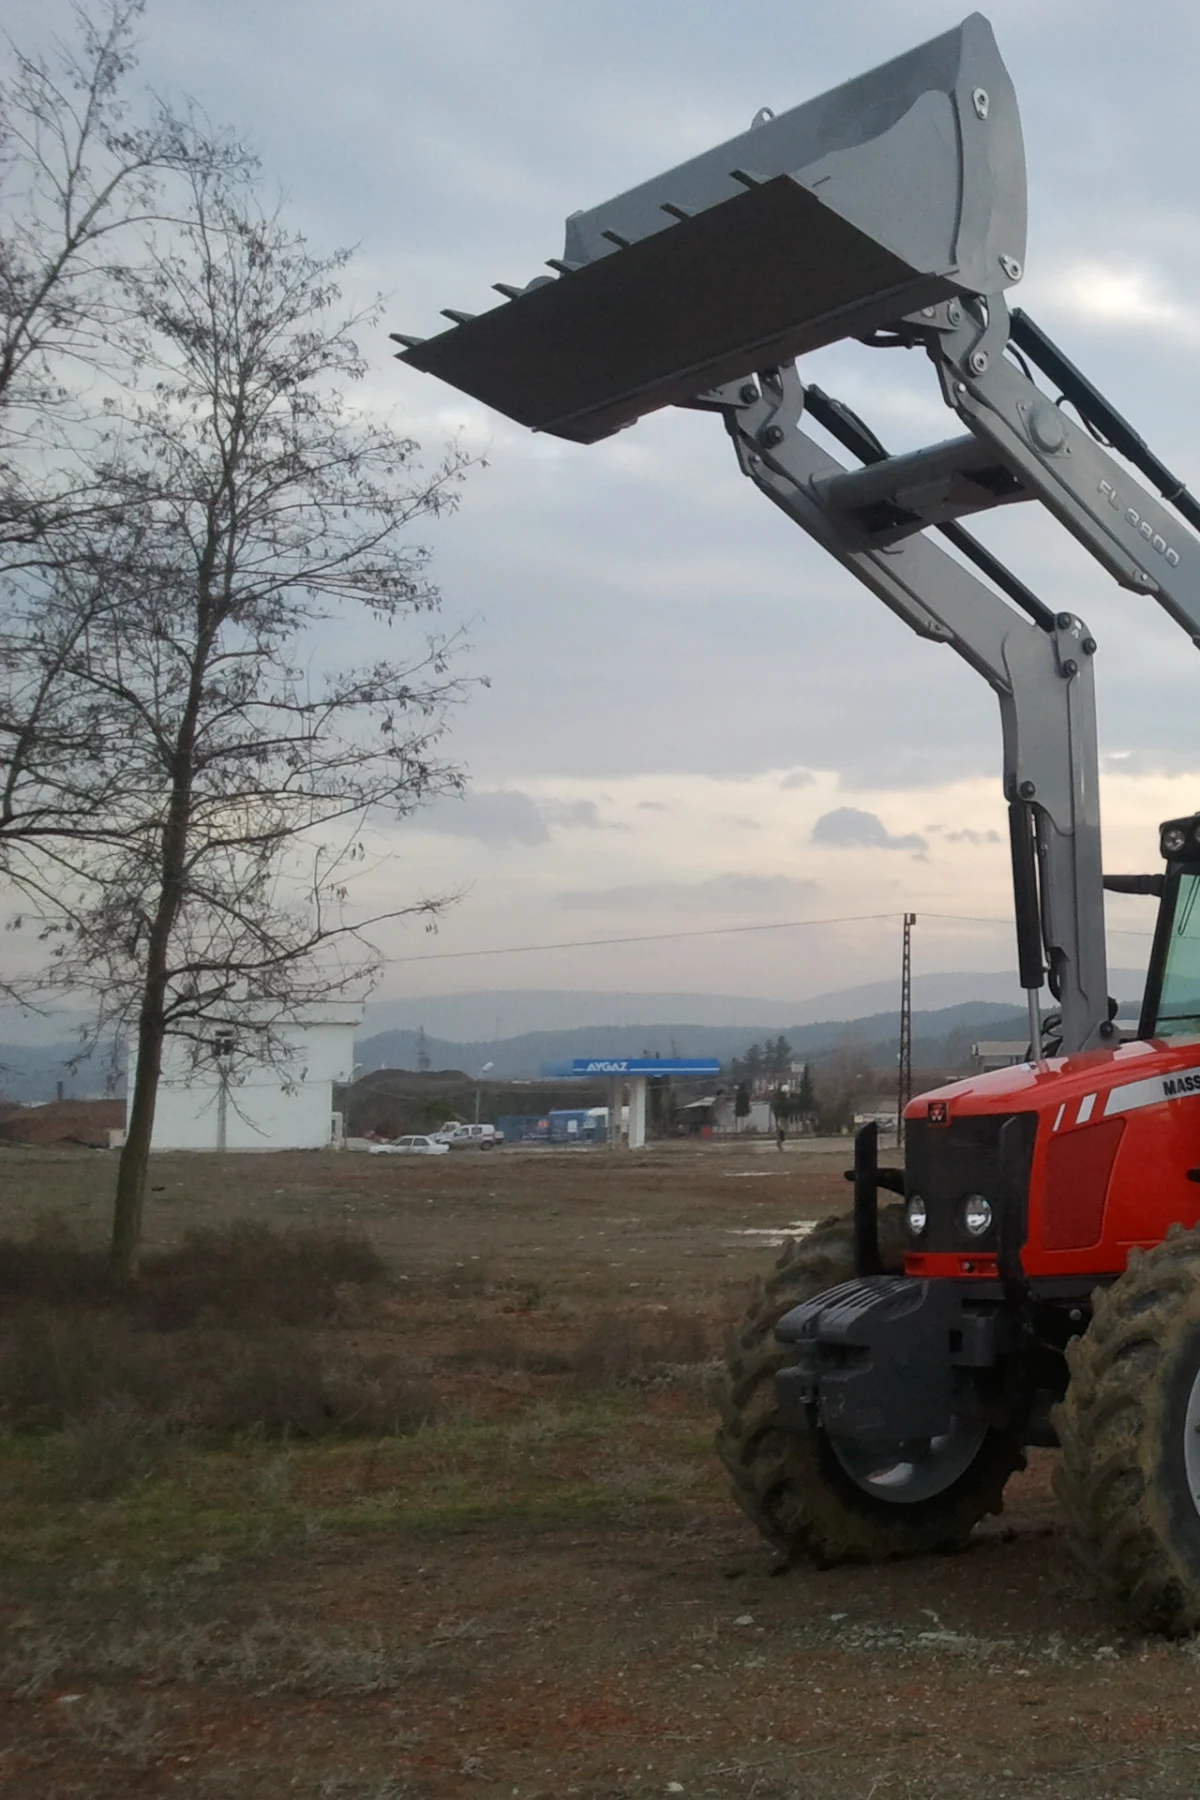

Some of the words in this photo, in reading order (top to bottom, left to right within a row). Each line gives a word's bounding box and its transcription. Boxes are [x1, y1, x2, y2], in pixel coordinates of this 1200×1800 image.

[1097, 478, 1119, 511] FL
[1125, 507, 1181, 568] 3800
[586, 1061, 629, 1073] AYGAZ
